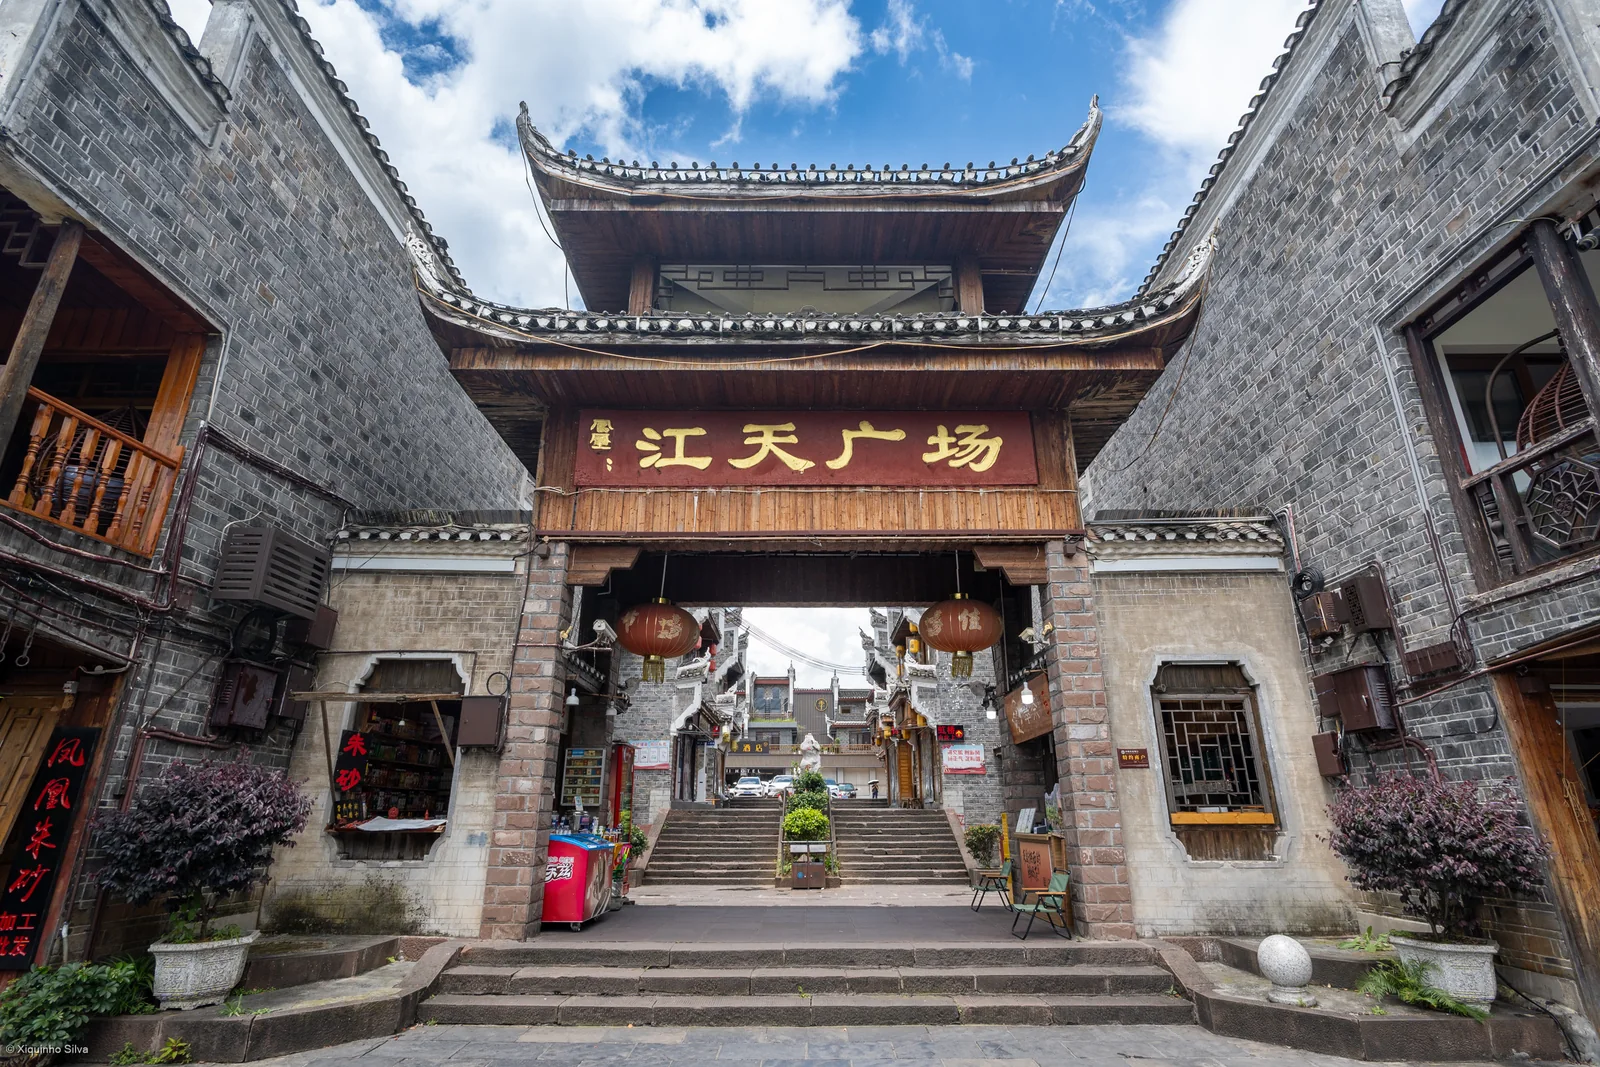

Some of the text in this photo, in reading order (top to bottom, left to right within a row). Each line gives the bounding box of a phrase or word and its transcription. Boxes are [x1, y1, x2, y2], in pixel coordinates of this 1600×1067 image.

[635, 420, 1003, 473] 江天广场
[336, 733, 367, 791] 朱砂
[9, 737, 85, 902] 凤凰朱砂
[0, 911, 37, 931] 加工
